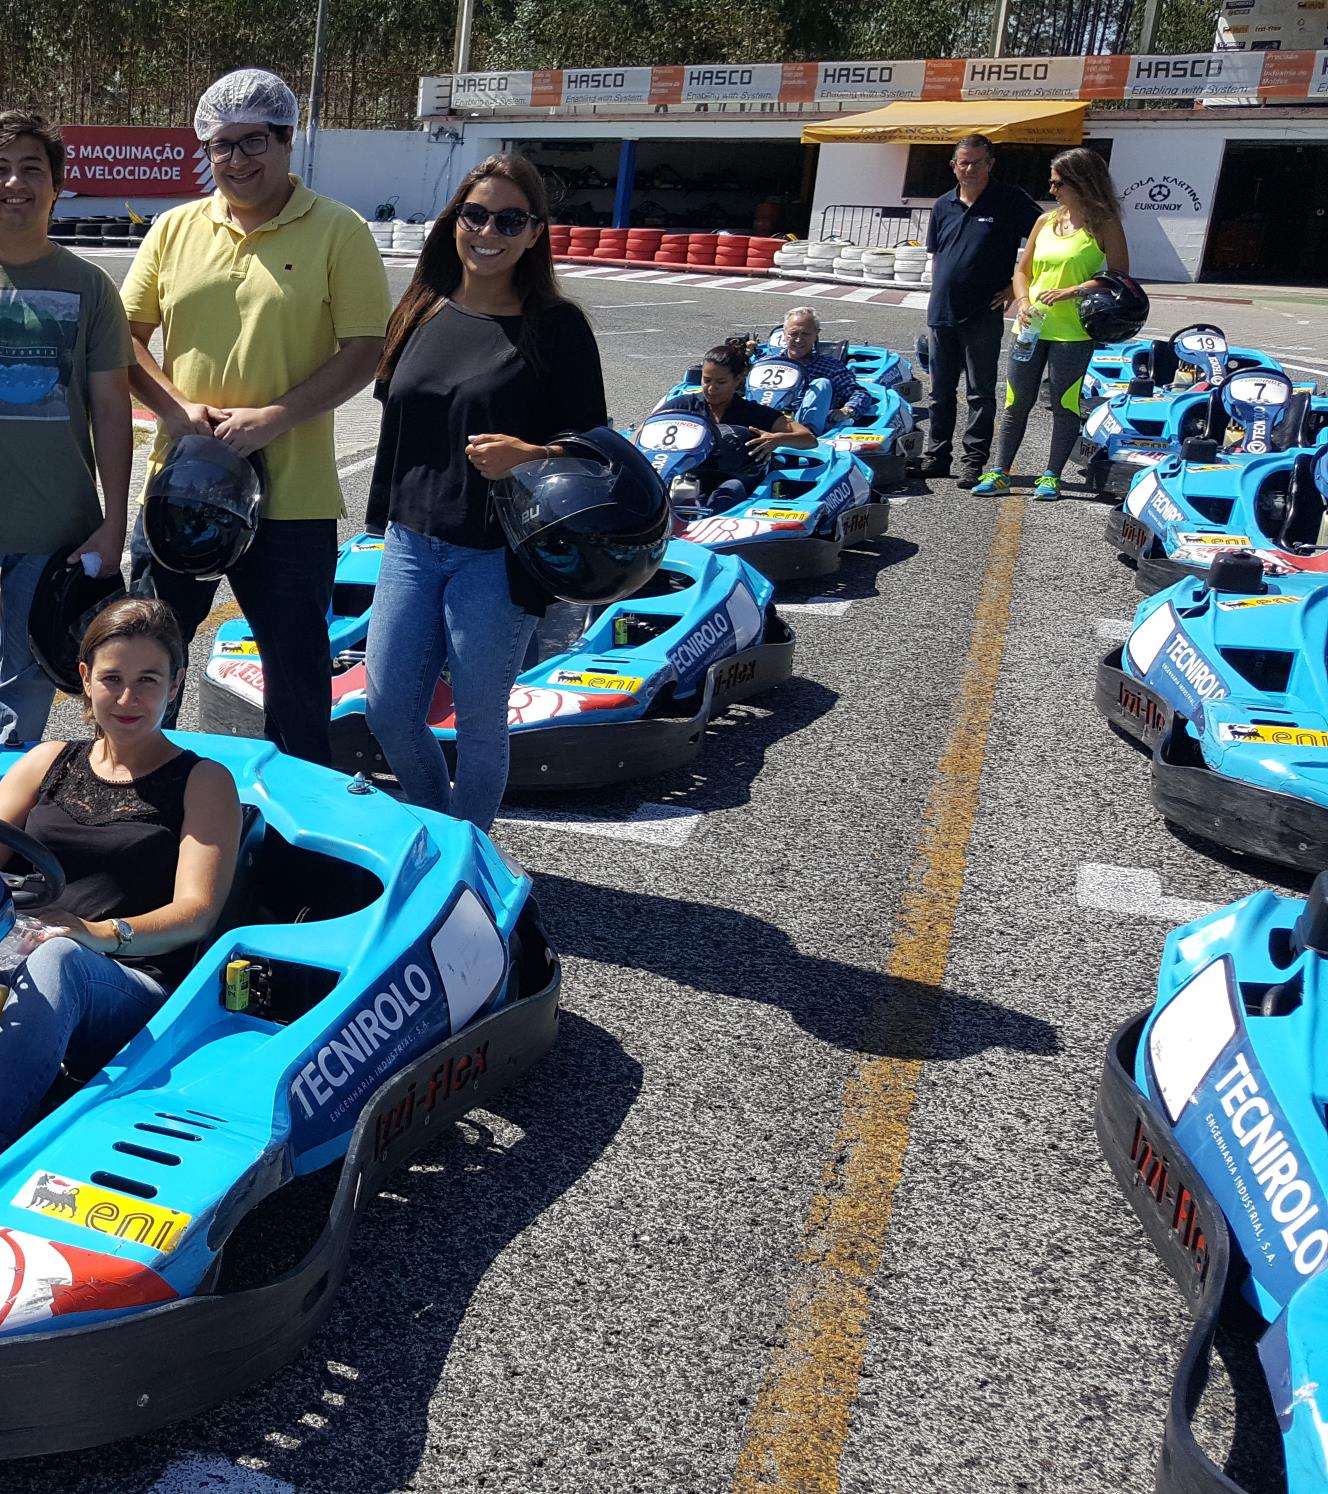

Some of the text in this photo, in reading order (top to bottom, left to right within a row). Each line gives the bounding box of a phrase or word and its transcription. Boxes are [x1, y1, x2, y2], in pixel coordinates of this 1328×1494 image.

[689, 69, 752, 86] HASCO
[823, 66, 893, 84] HASCO
[970, 63, 1049, 82] HASCO
[1135, 59, 1224, 79] HASCO
[455, 76, 509, 94] HASCO
[567, 73, 625, 89] HASCO
[967, 87, 1009, 97] Enabling
[1012, 88, 1032, 97] with
[1131, 85, 1179, 96] Enabling
[1181, 85, 1204, 95] with
[79, 143, 185, 163] MAQUINAÇÃO
[84, 166, 182, 180] VELOCIDADE
[1162, 175, 1202, 212] KARTING
[1134, 202, 1183, 212] EUROINDY
[1196, 337, 1216, 350] 19
[760, 368, 785, 386] 25
[1254, 382, 1267, 400] 7
[661, 425, 678, 446] 8
[670, 612, 729, 675] ECNIROLO
[290, 963, 432, 1119] TECNIROLO
[329, 1075, 374, 1123] ENGENHARIA
[1205, 1111, 1235, 1176] ENGENHARIA
[1215, 1052, 1328, 1275] TECNIROLO
[84, 1200, 184, 1251] eni
